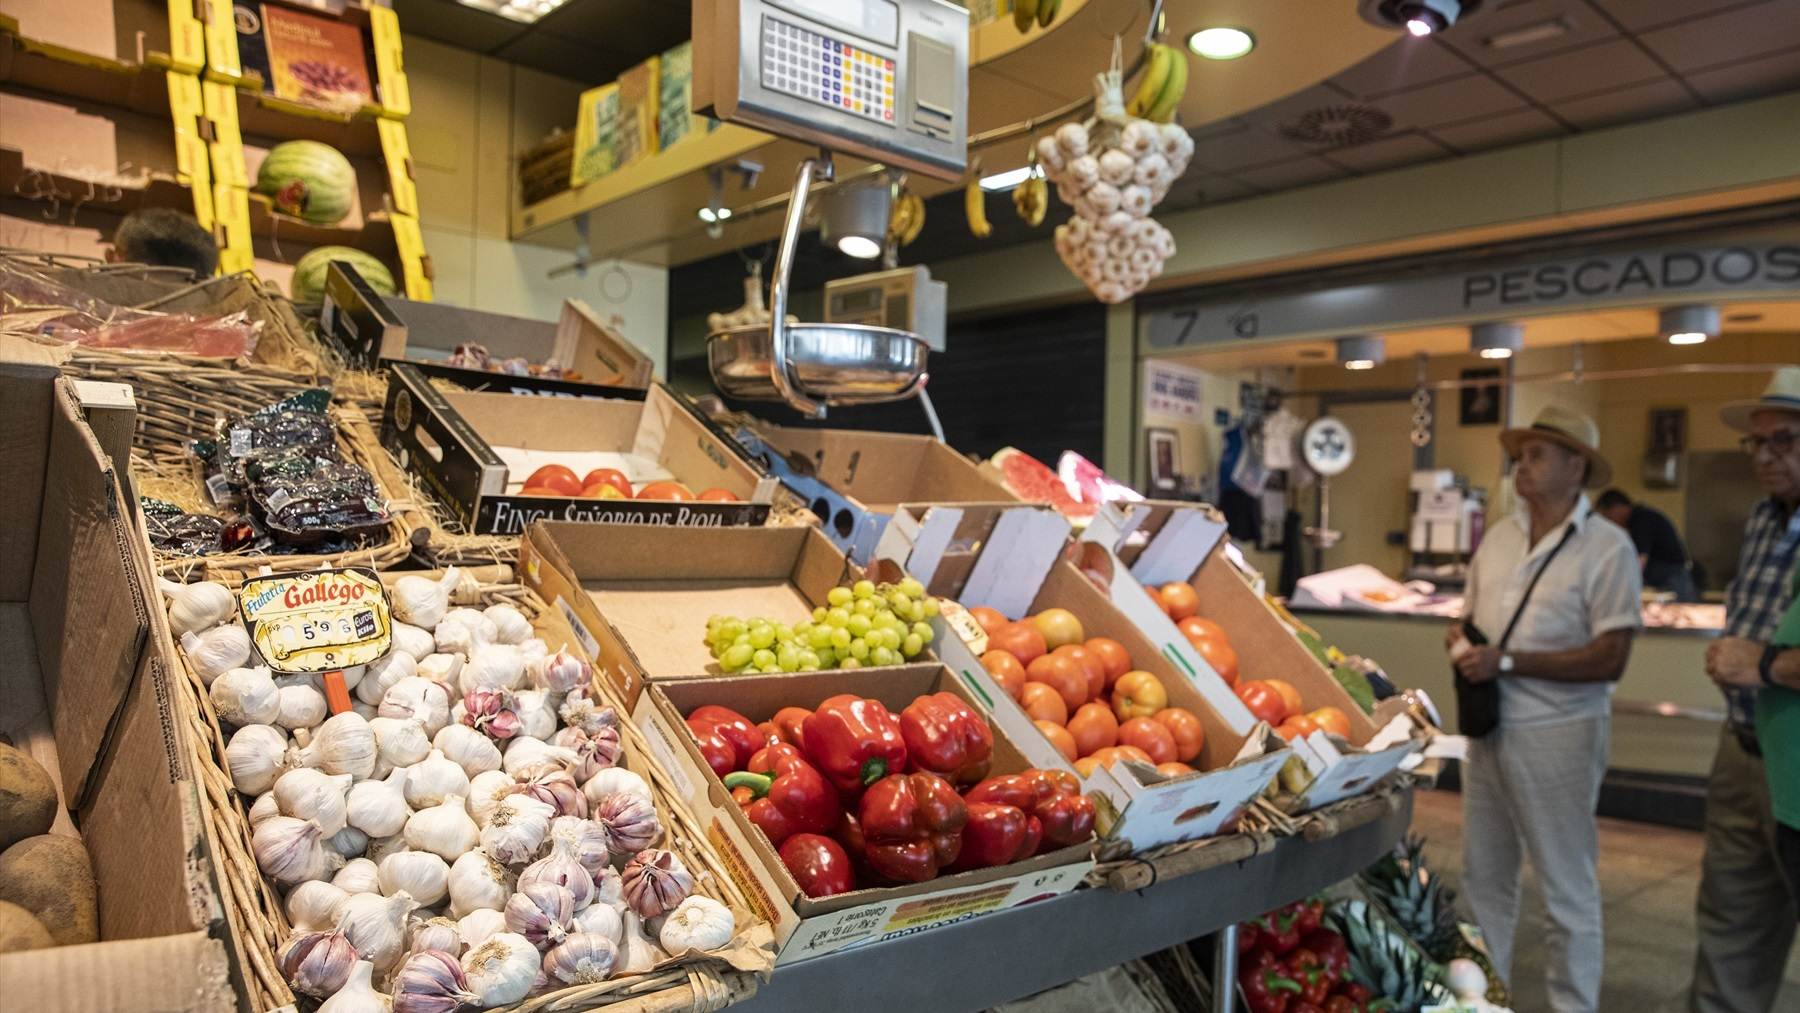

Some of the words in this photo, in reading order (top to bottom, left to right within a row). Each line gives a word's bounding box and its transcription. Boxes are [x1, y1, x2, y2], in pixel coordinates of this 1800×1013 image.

[1463, 247, 1800, 307] PESCADOS
[1173, 309, 1198, 345] 7
[284, 581, 366, 609] Gallego
[355, 612, 373, 627] Euros
